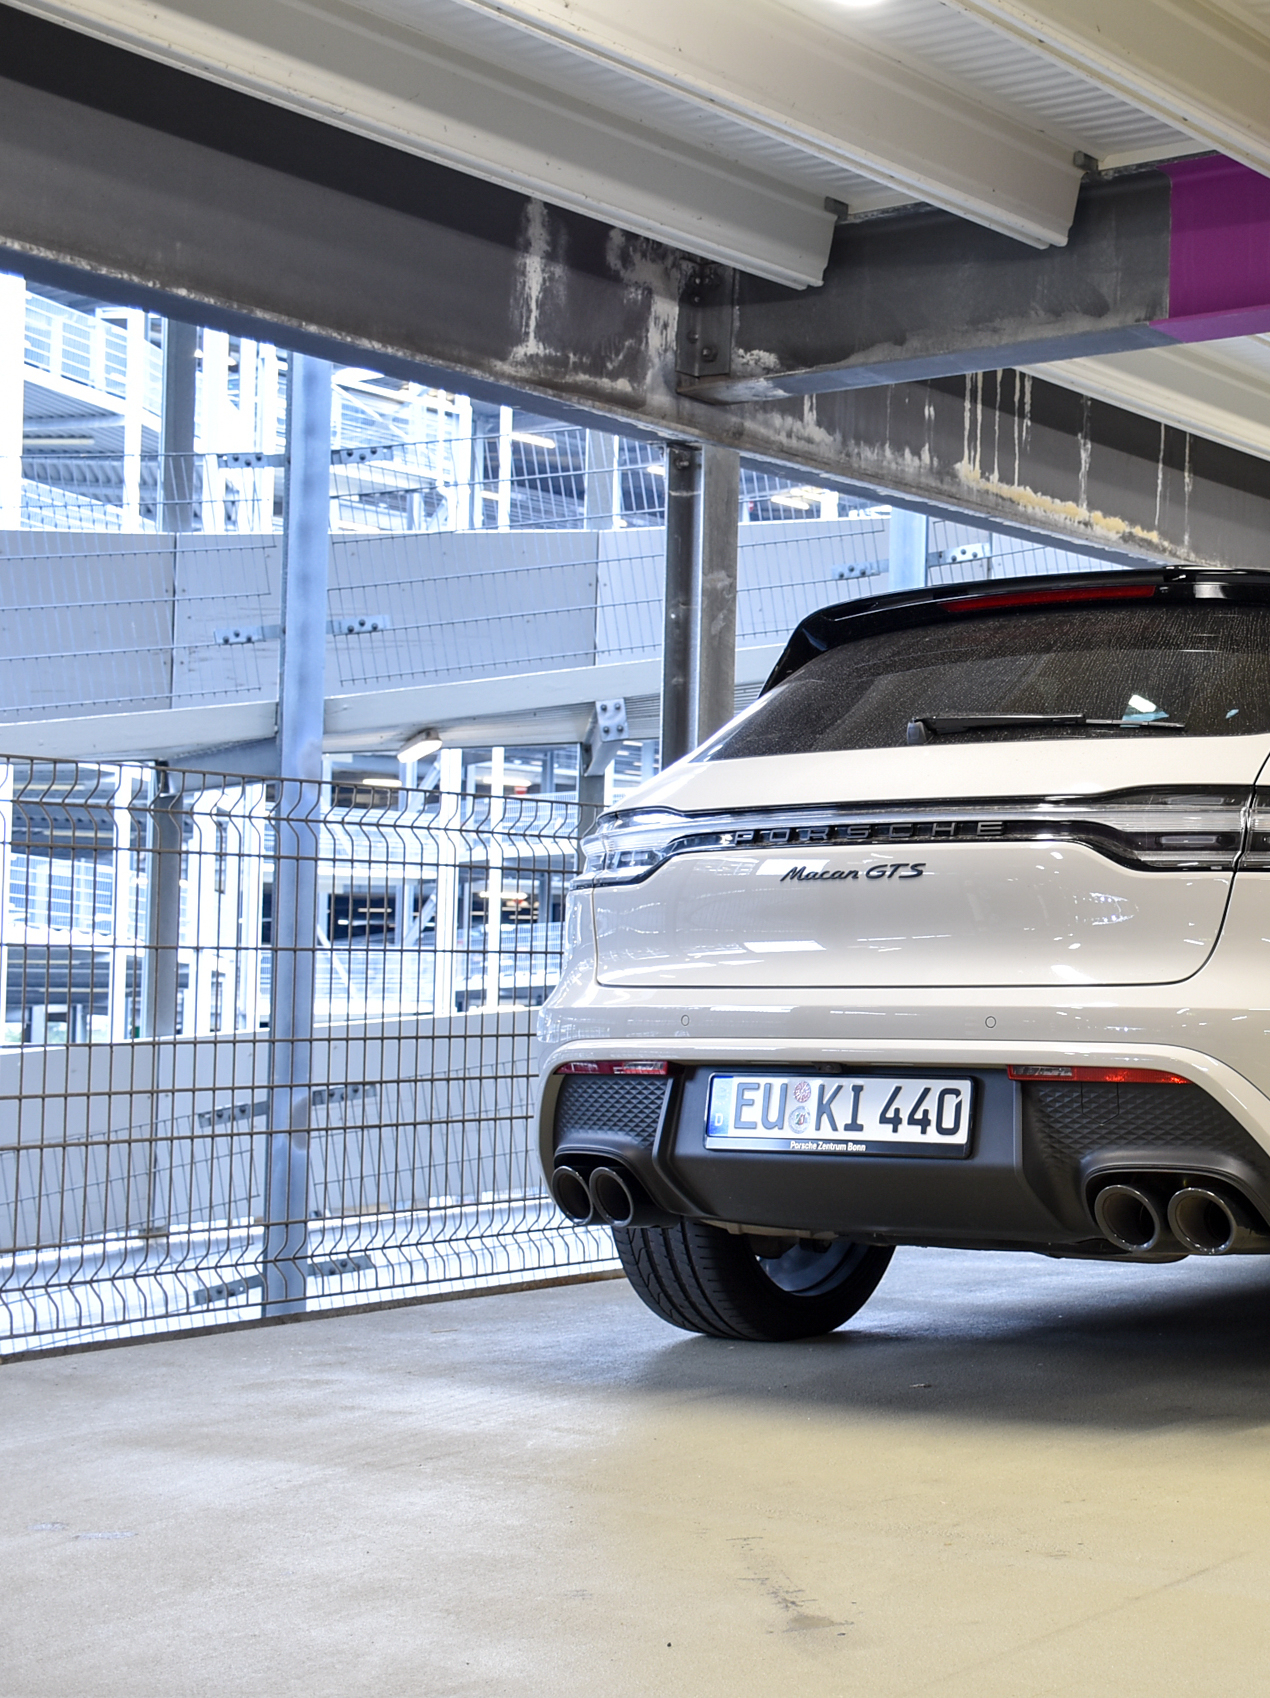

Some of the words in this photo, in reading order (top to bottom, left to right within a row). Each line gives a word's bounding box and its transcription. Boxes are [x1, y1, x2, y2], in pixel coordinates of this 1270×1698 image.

[734, 821, 1003, 845] PORSCHE
[780, 865, 859, 882] Macan
[865, 862, 926, 879] GTS
[734, 1082, 788, 1130] EU
[815, 1084, 864, 1132] KI
[879, 1086, 963, 1136] 440
[714, 1112, 724, 1127] D
[790, 1140, 817, 1150] Porsche
[818, 1141, 846, 1151] Zentrum
[847, 1142, 866, 1152] Bonn
